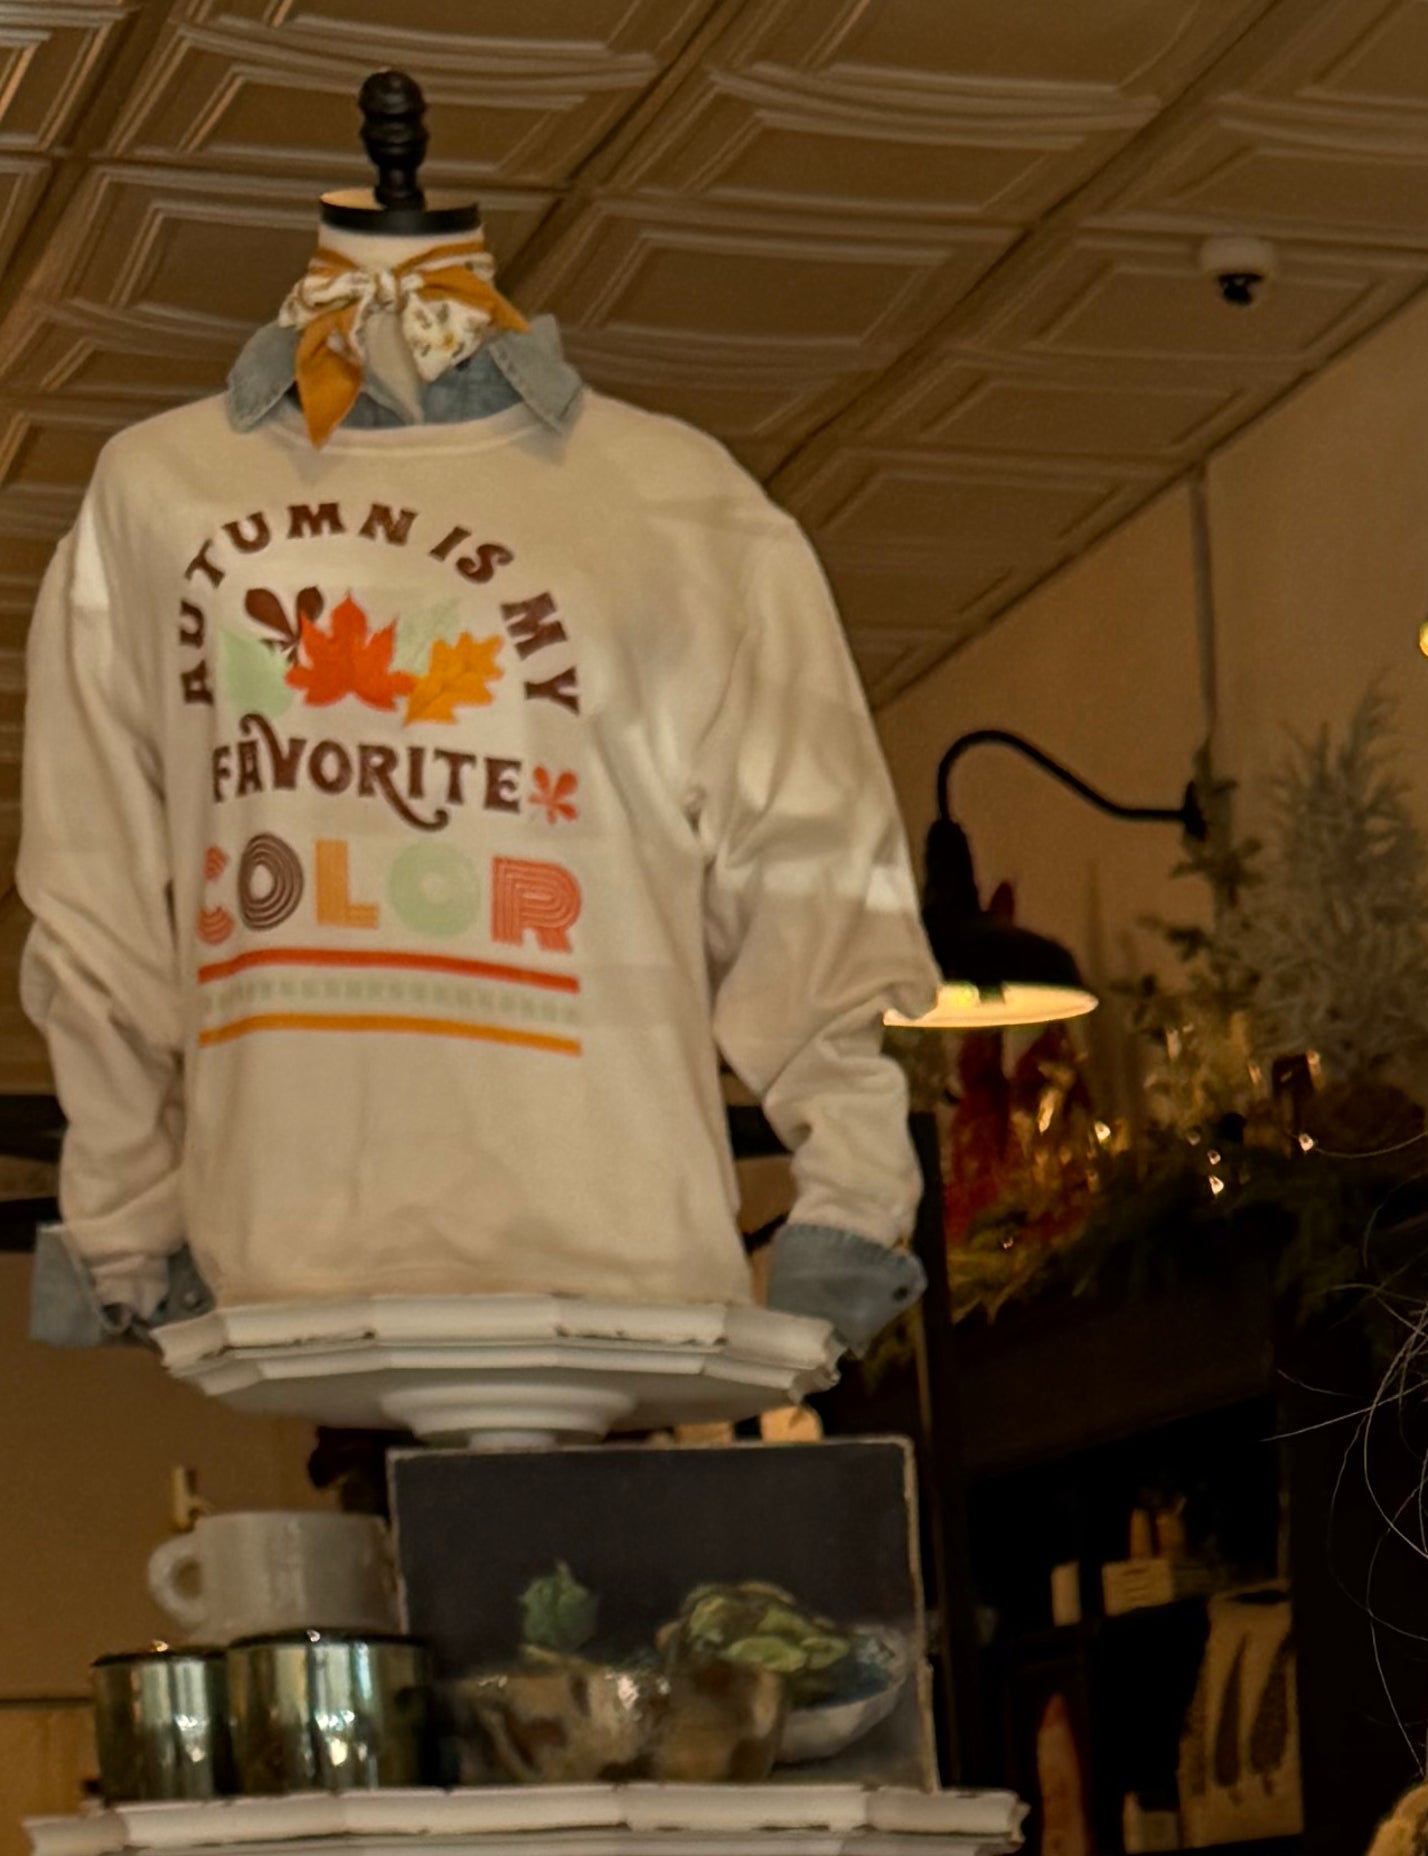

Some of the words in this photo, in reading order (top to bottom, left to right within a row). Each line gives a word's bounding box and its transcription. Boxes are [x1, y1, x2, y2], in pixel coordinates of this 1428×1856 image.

[179, 502, 419, 707] AUTUMN
[429, 526, 515, 584] IS
[501, 591, 580, 716] MY
[212, 713, 522, 832] FAVORITE
